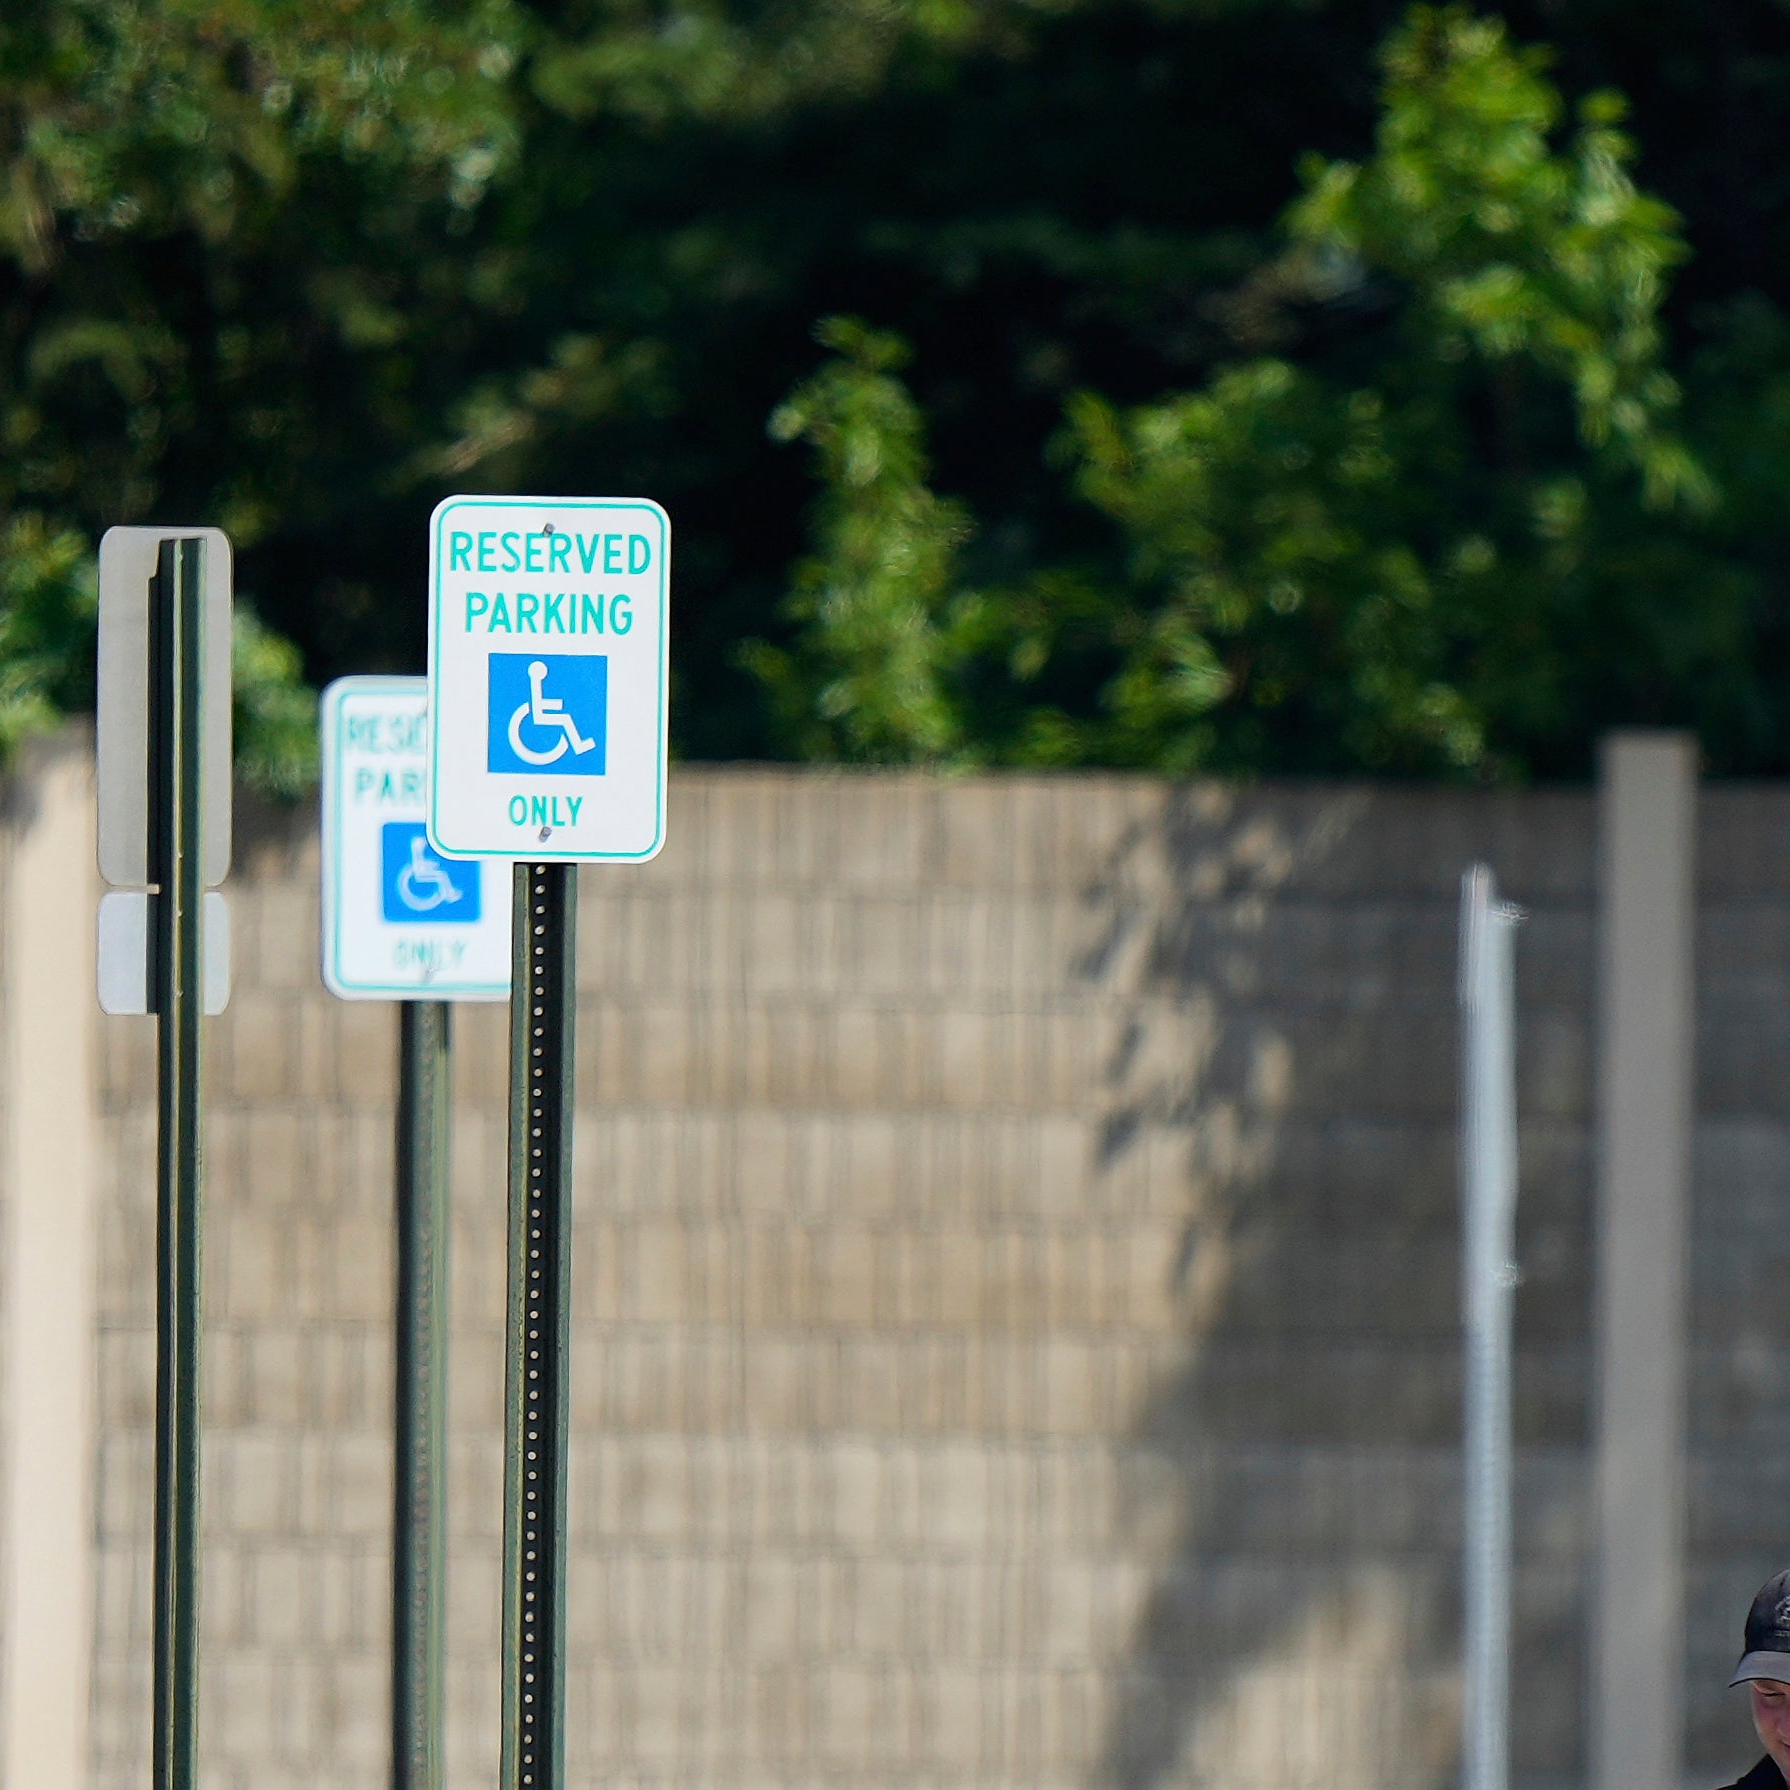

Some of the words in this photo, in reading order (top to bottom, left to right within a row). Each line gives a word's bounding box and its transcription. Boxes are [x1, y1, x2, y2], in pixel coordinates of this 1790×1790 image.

[449, 531, 652, 576] RESERVED
[464, 592, 634, 637] PARKING
[507, 795, 584, 828] ONLY
